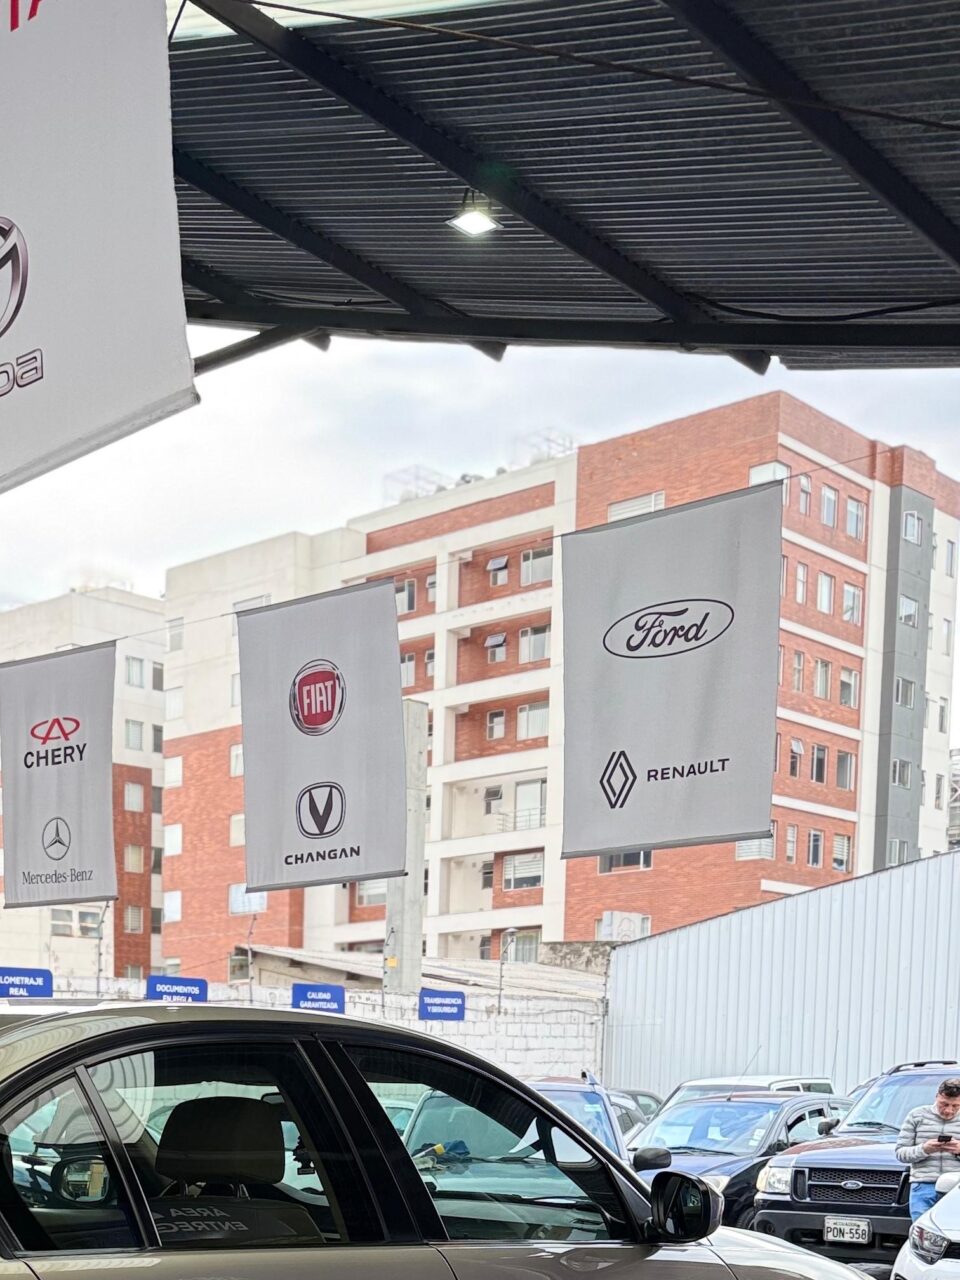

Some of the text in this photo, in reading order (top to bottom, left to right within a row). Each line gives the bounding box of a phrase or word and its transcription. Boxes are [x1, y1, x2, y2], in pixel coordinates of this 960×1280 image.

[626, 607, 710, 652] Ford
[302, 680, 334, 716] FIAT
[24, 743, 87, 769] CHERY
[647, 758, 730, 782] RENAULT
[284, 846, 361, 866] CHANGAN
[22, 868, 93, 885] Mercedes-Benz
[9, 986, 29, 995] REAL
[156, 983, 200, 994] DOCUMENTOS
[307, 991, 331, 1000] CALIDAD
[299, 1000, 339, 1010] GARANTIZADA
[826, 1226, 867, 1241] PON-558
